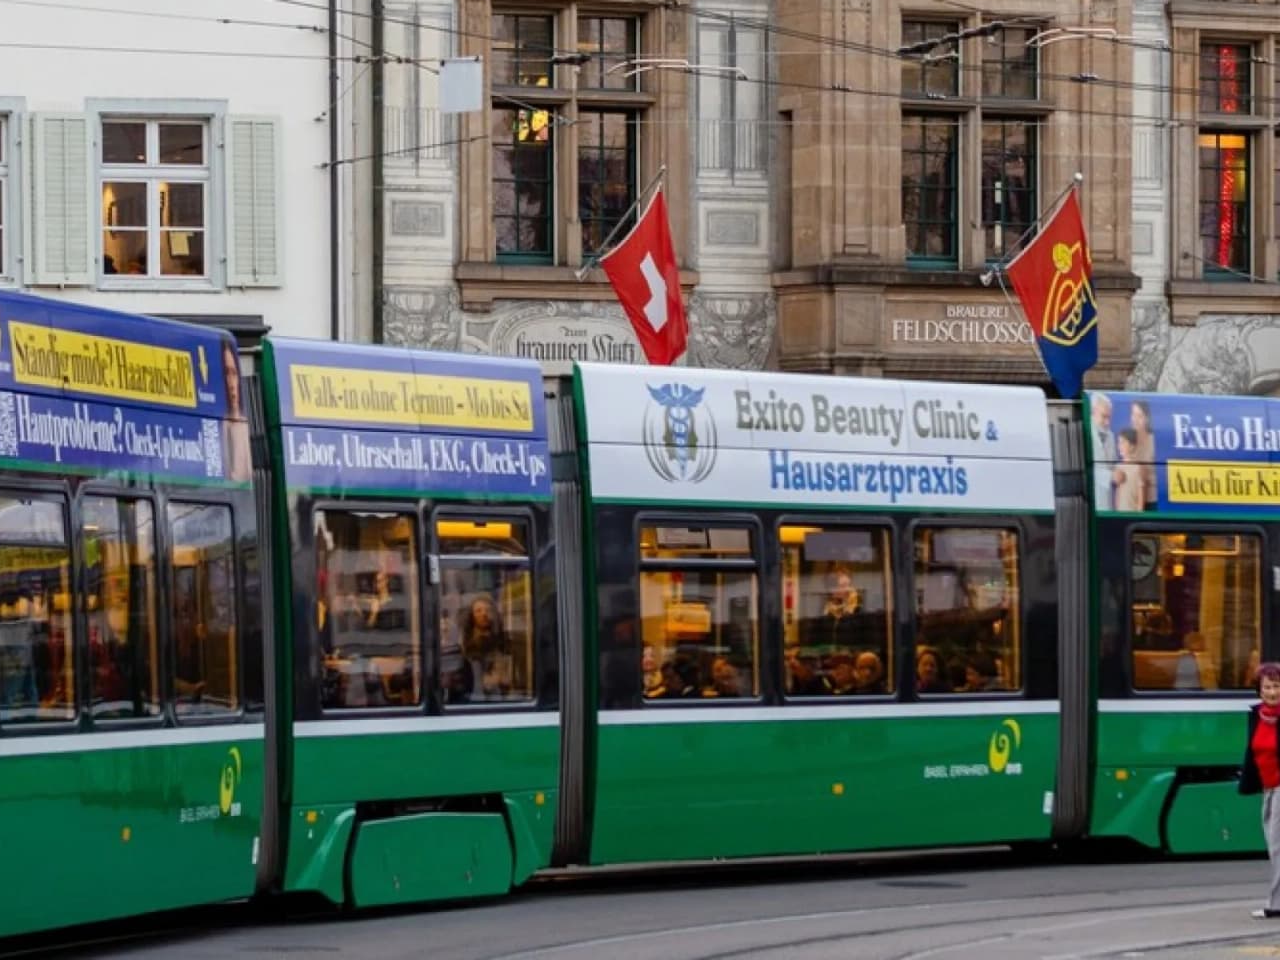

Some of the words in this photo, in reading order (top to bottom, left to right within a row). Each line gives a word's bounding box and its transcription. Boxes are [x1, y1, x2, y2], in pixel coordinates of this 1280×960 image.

[946, 305, 1009, 318] BRAUEREI
[12, 326, 70, 381] Ständig
[71, 340, 114, 389] müde?
[114, 344, 193, 400] Haarausfall?
[294, 373, 359, 410] Walk-in
[361, 379, 397, 412] ohne
[398, 381, 455, 417] Termin
[465, 386, 490, 419] Mo
[490, 387, 512, 420] bis
[512, 389, 530, 421] Sa
[734, 390, 805, 433] Exito
[812, 394, 905, 447] Beauty
[913, 400, 981, 440] Clinic
[985, 420, 999, 441] &
[15, 393, 124, 462] Hautprobleme?
[1172, 413, 1239, 451] Exito
[287, 431, 342, 471] Labor,
[342, 433, 429, 475] Ultraschall,
[429, 438, 470, 475] EKG,
[472, 440, 547, 486] Check-Ups
[769, 449, 969, 503] Hausarztpraxis
[1172, 469, 1221, 497] Auch
[1225, 470, 1255, 497] für
